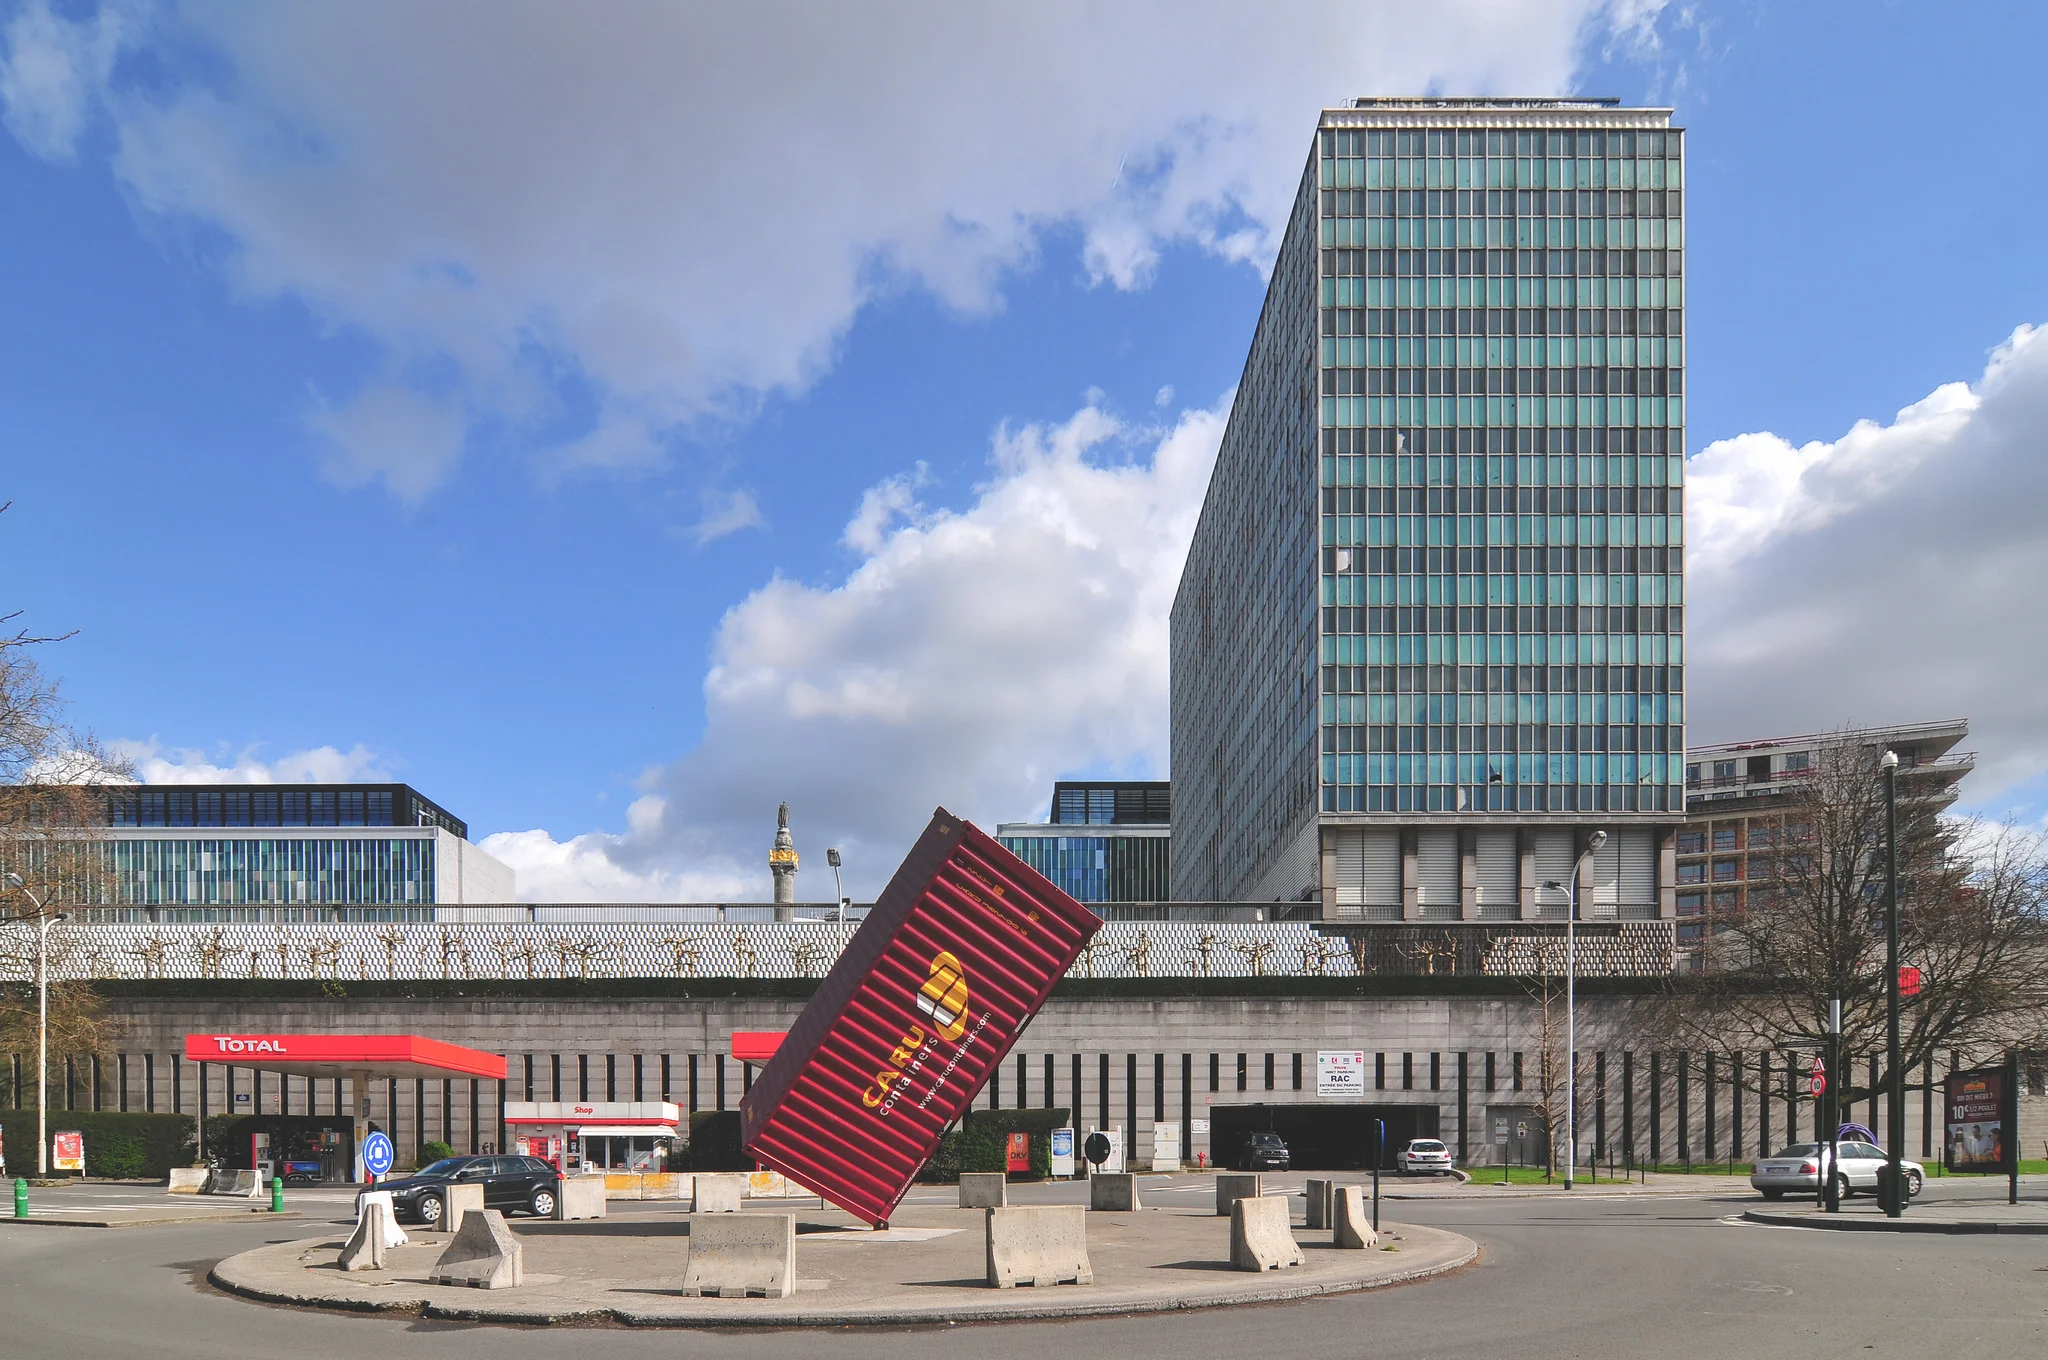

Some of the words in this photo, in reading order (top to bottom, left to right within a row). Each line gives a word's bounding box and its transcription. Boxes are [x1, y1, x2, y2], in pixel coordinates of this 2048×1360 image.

[214, 1037, 287, 1052] TOTAL
[862, 1025, 925, 1108] CARU
[917, 1011, 991, 1110] www.carucontainers.com
[879, 1037, 938, 1116] containers
[574, 1106, 594, 1115] Shop
[1010, 1152, 1027, 1160] DKV
